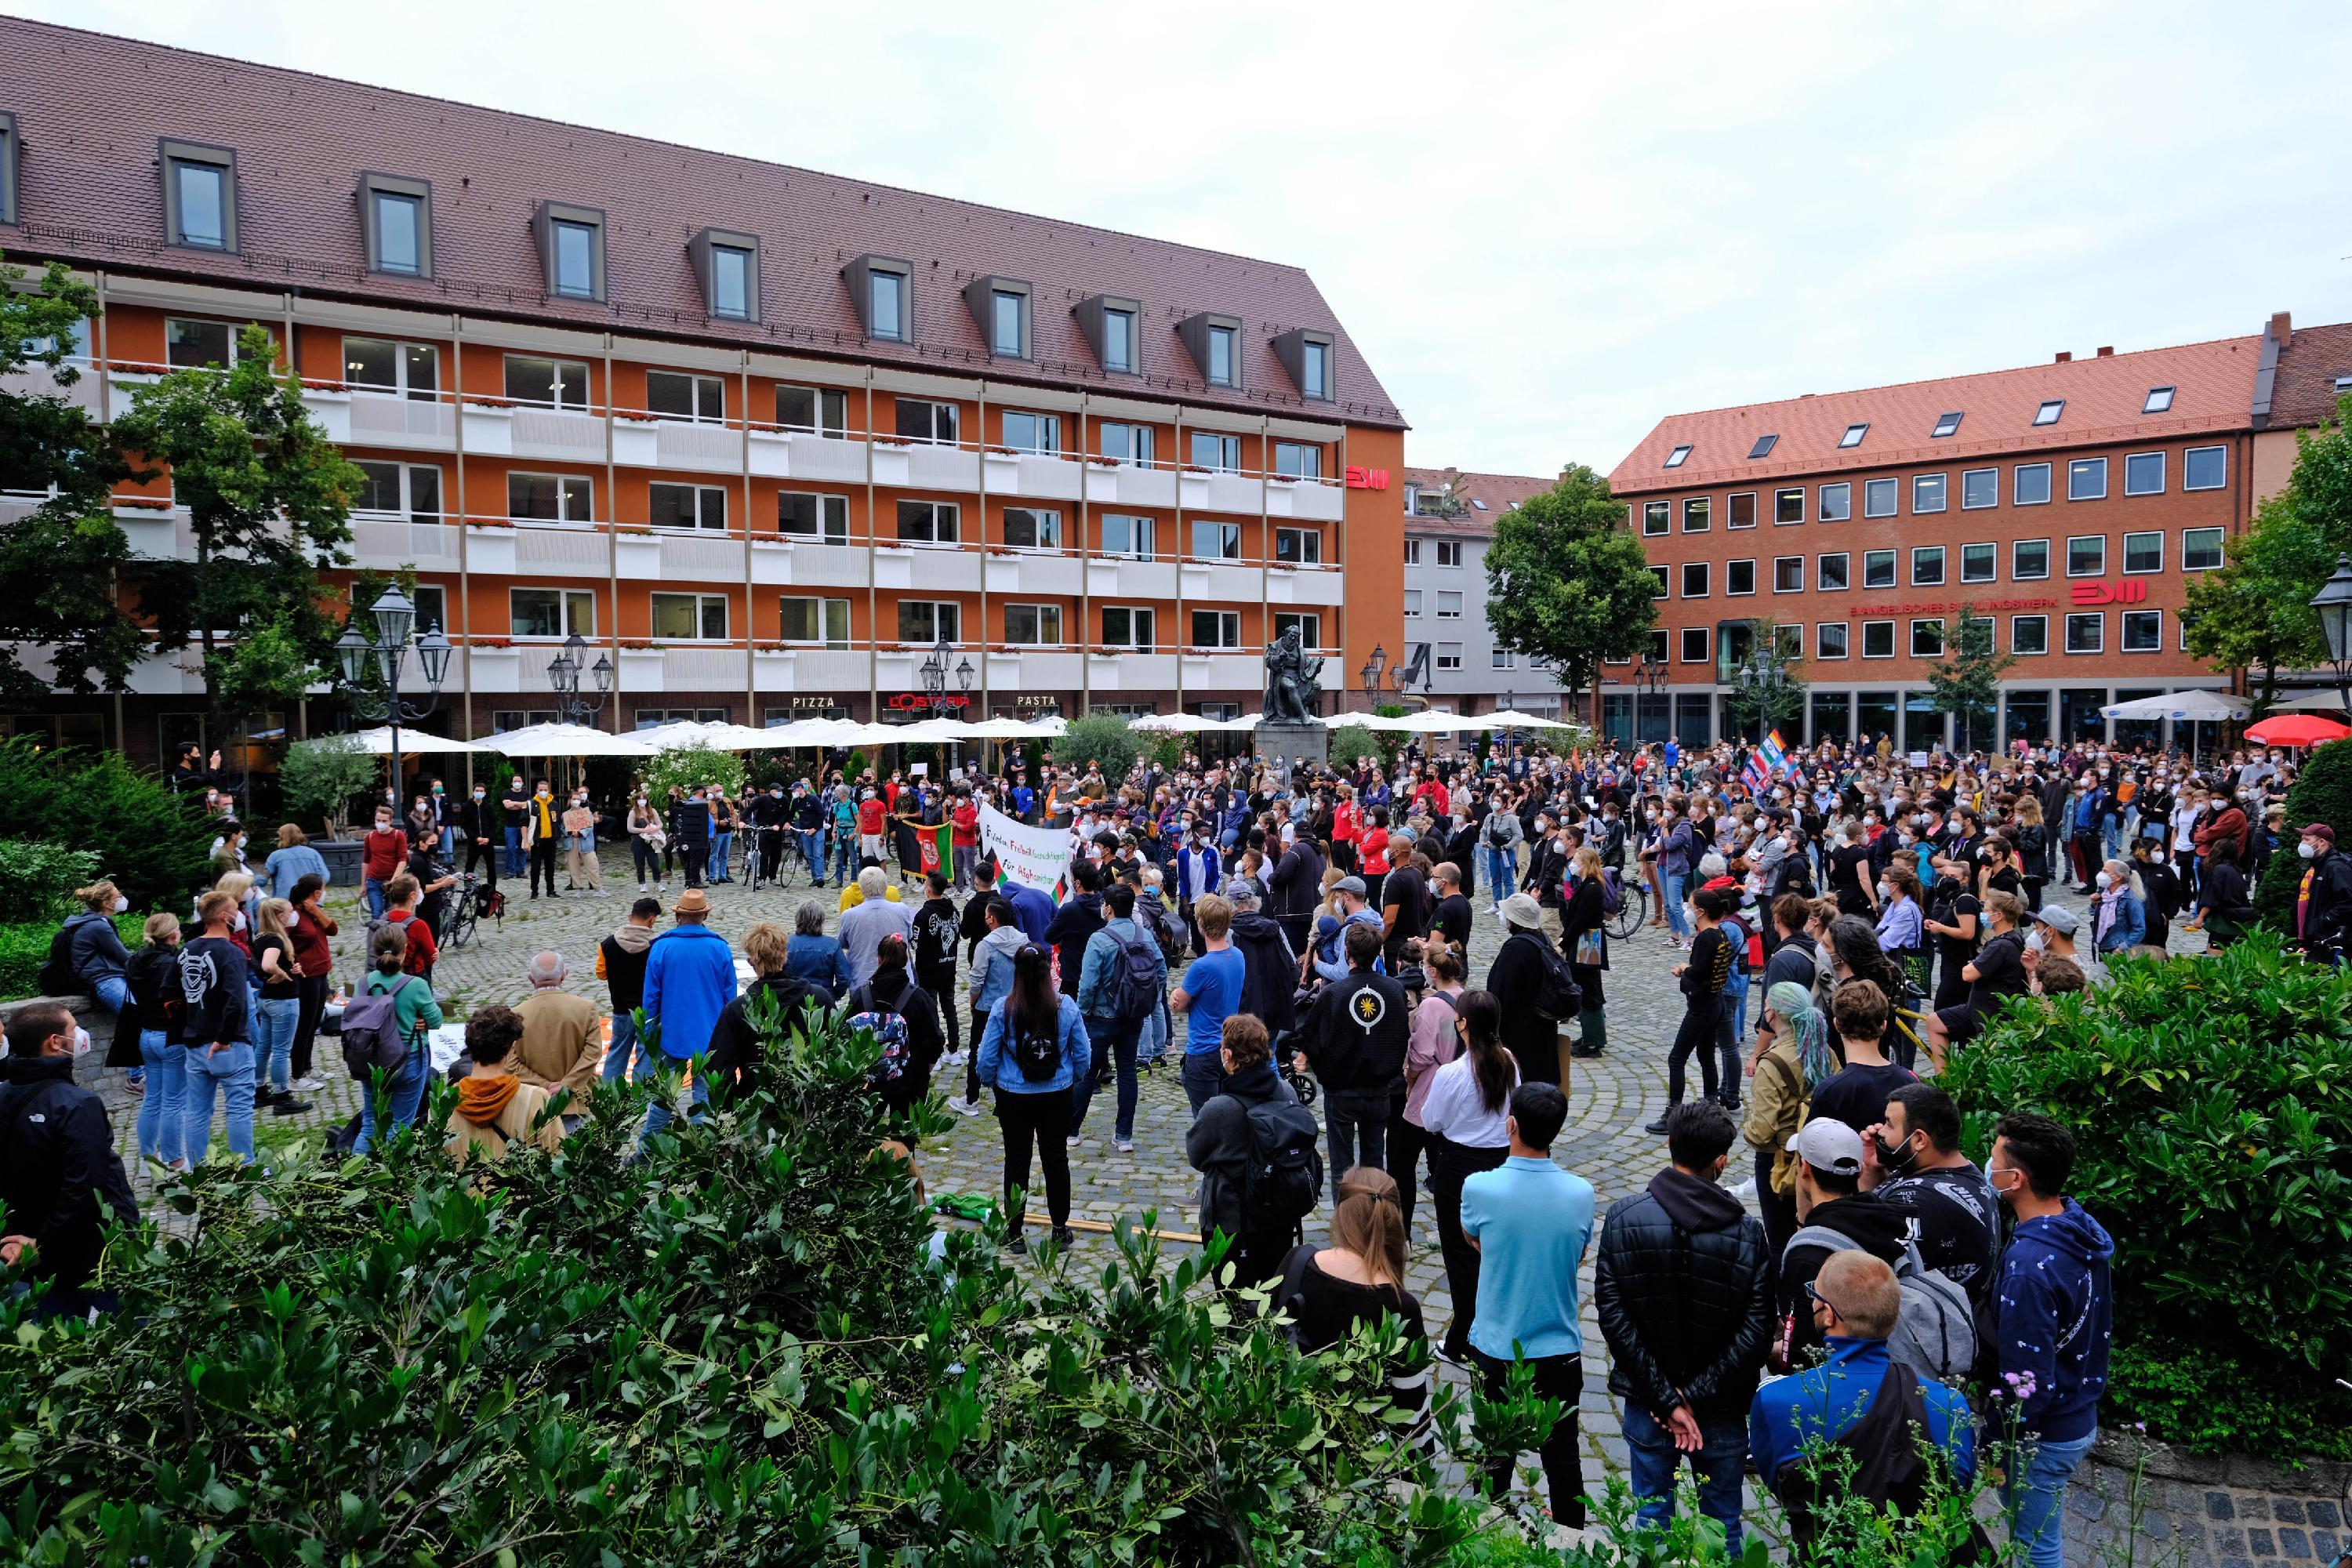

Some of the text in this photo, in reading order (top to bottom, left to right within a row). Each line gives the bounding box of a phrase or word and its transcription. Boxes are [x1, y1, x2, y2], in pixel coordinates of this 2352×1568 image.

[1849, 597, 2058, 616] EVANGELISCHES SILUNGSWERK
[793, 697, 834, 708] PIZZA
[1017, 696, 1056, 706] PASTA
[1952, 1185, 1985, 1214] NIKE
